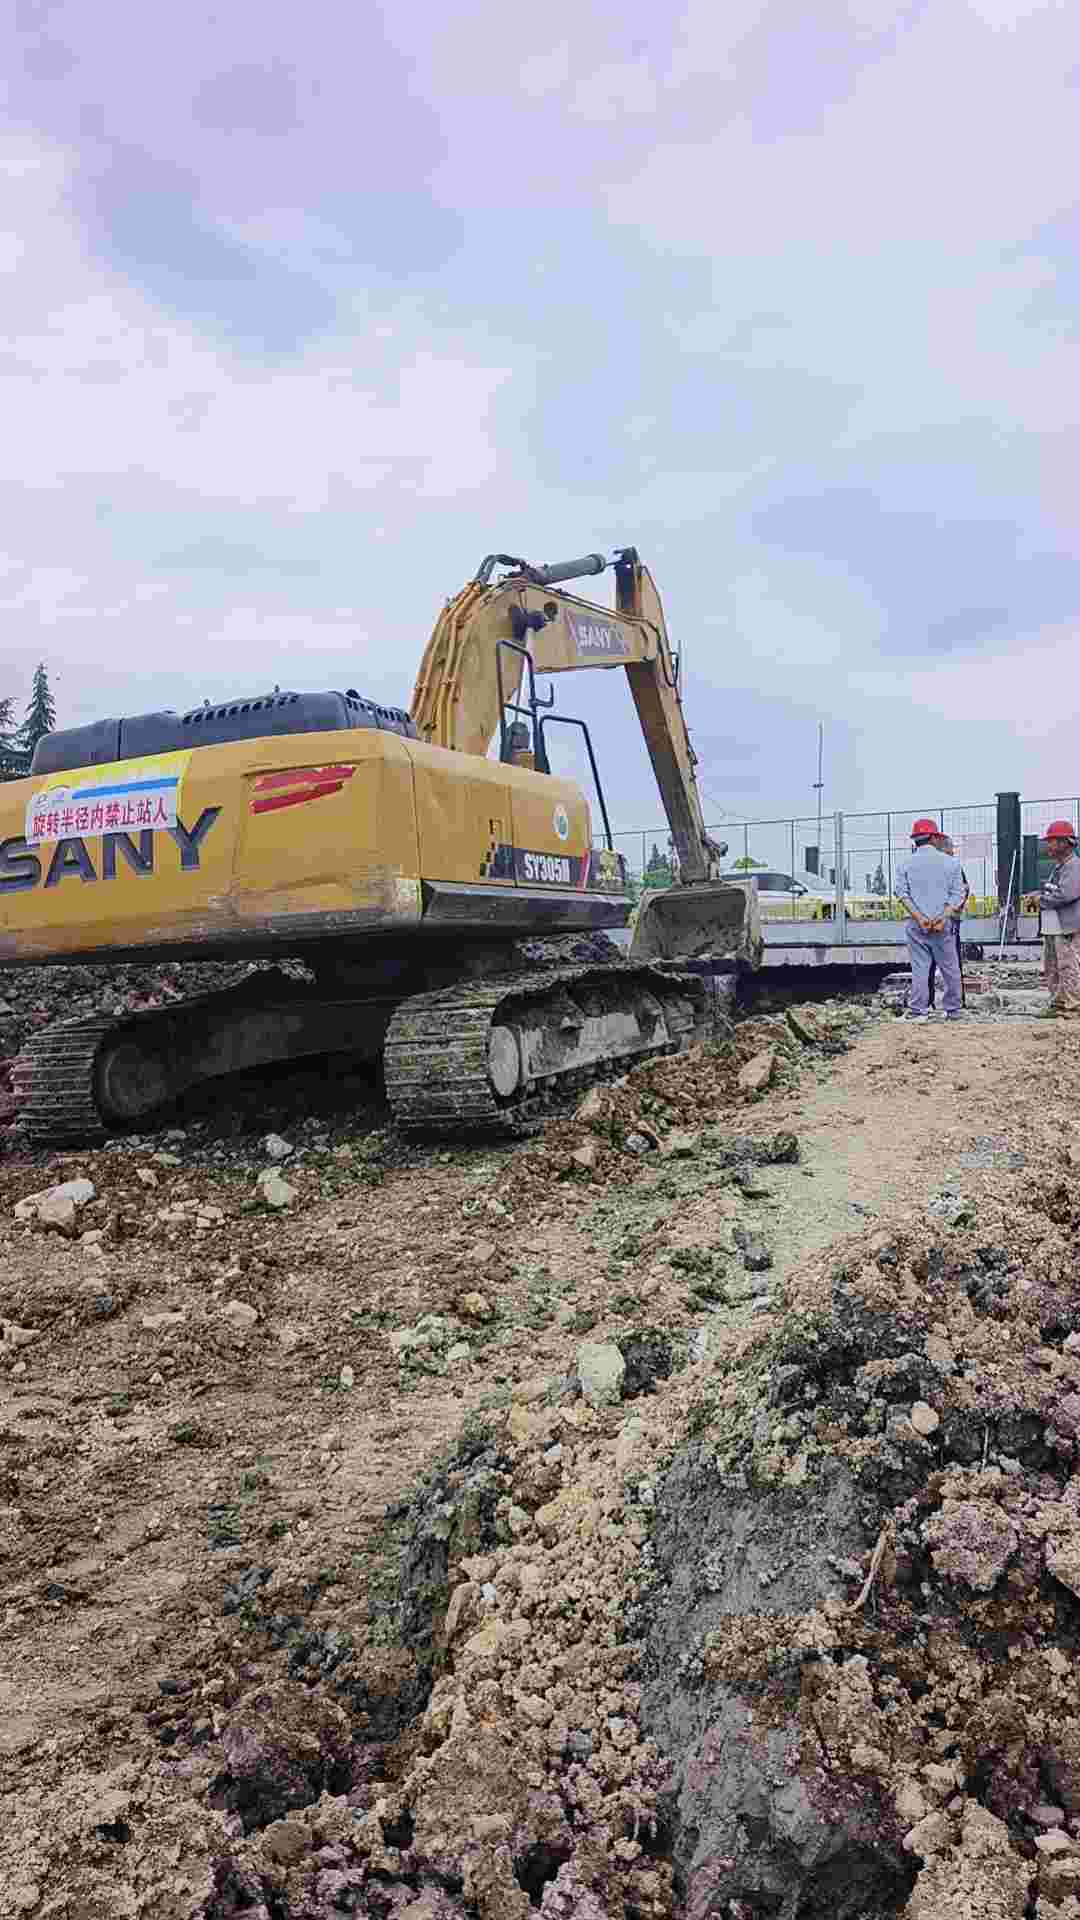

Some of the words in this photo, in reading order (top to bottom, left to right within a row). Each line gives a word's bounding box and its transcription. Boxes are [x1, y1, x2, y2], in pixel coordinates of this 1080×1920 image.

[577, 624, 613, 649] SANY
[32, 797, 168, 838] 旋转半径内禁止站人
